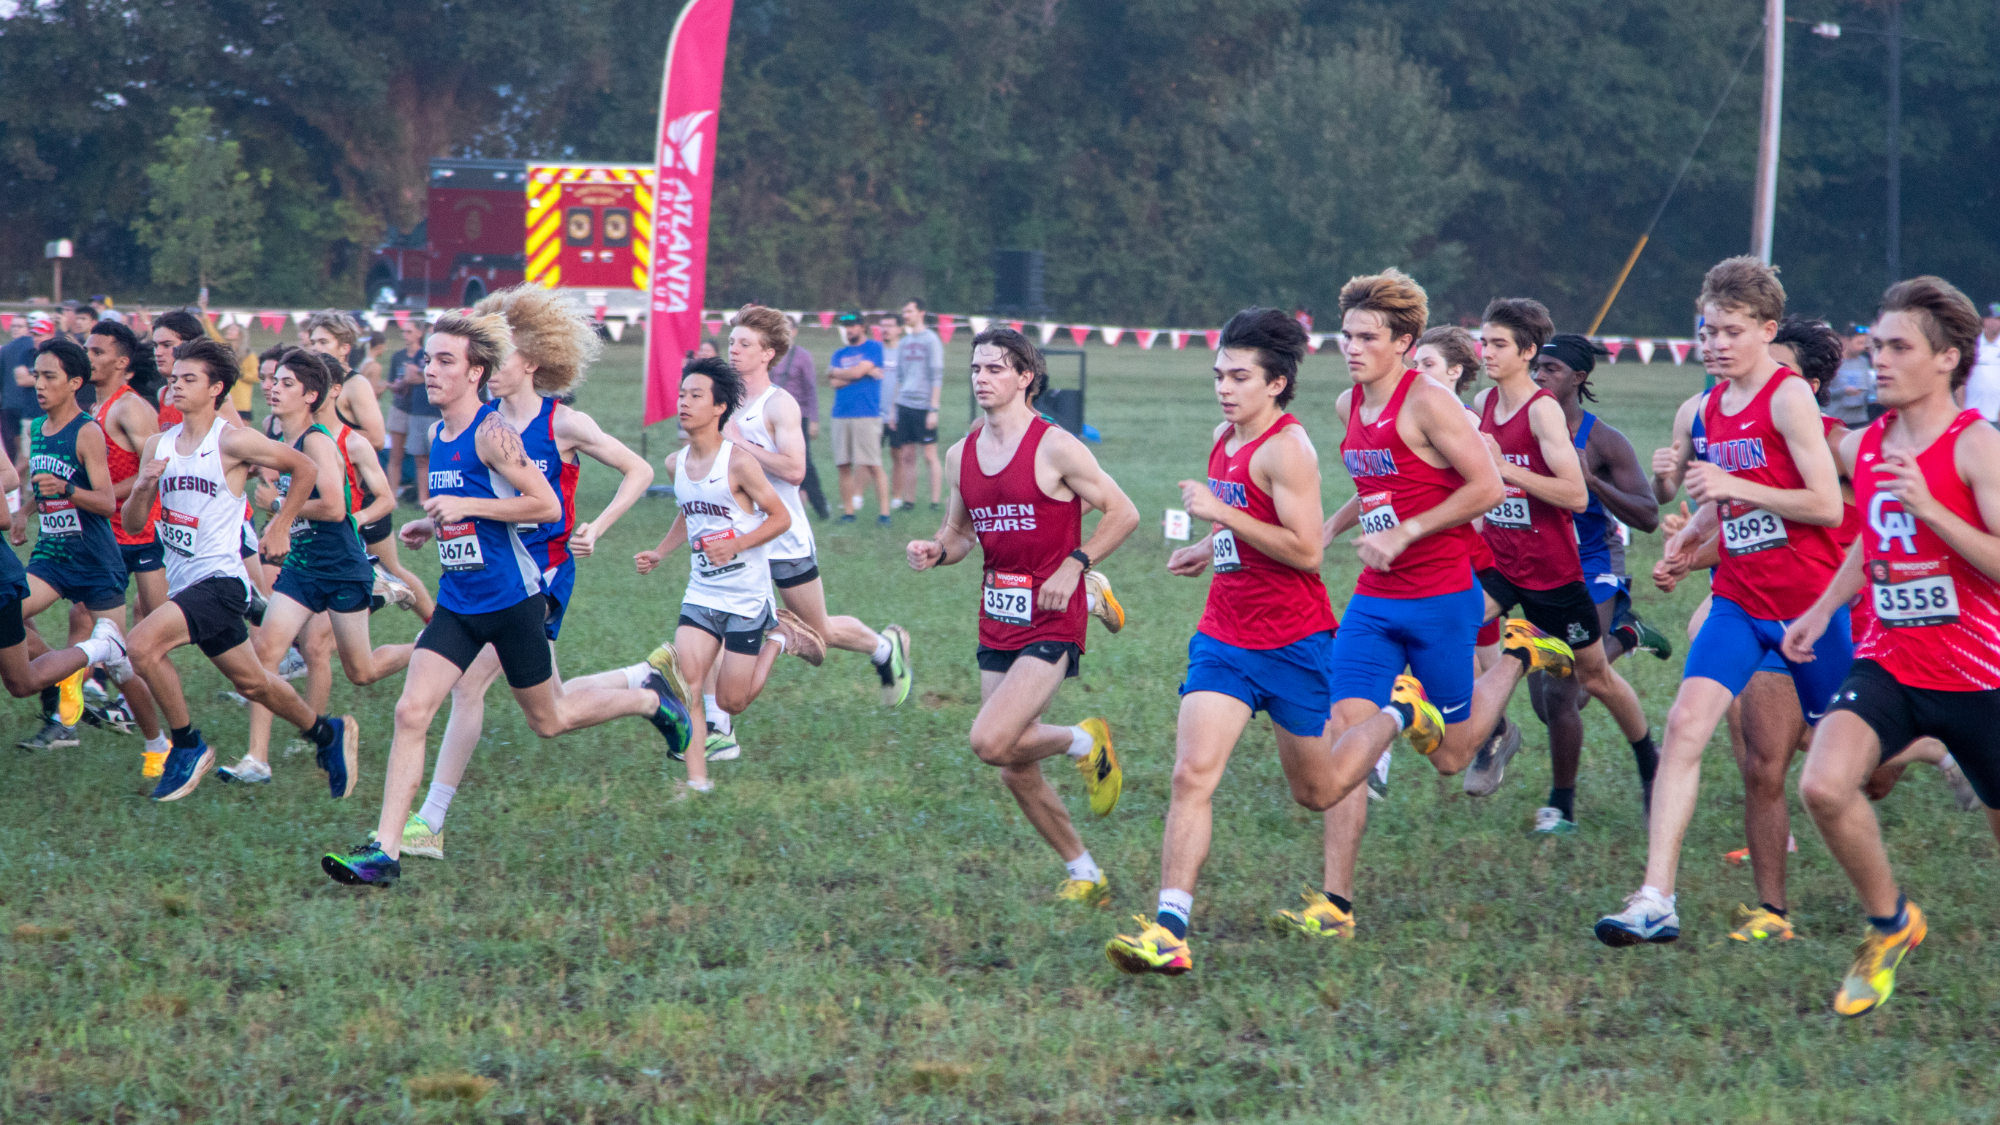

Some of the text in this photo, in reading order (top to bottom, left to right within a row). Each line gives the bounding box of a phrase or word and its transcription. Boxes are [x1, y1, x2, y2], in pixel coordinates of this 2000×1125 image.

[657, 178, 674, 245] TRACK
[666, 179, 693, 313] ATLANTA
[162, 475, 218, 498] AKESIDE
[683, 500, 733, 520] AKESIDE
[42, 514, 77, 529] 4002
[973, 518, 1037, 532] BEARS
[1726, 514, 1778, 542] 3693
[162, 523, 193, 547] 3593
[440, 542, 477, 560] 3674
[1214, 537, 1233, 559] 689
[1892, 561, 1940, 571] WINGFOOT
[996, 573, 1028, 583] WINGFOOT
[987, 590, 1027, 613] 3578
[1880, 586, 1949, 611] 3558
[411, 835, 439, 848] HOKA
